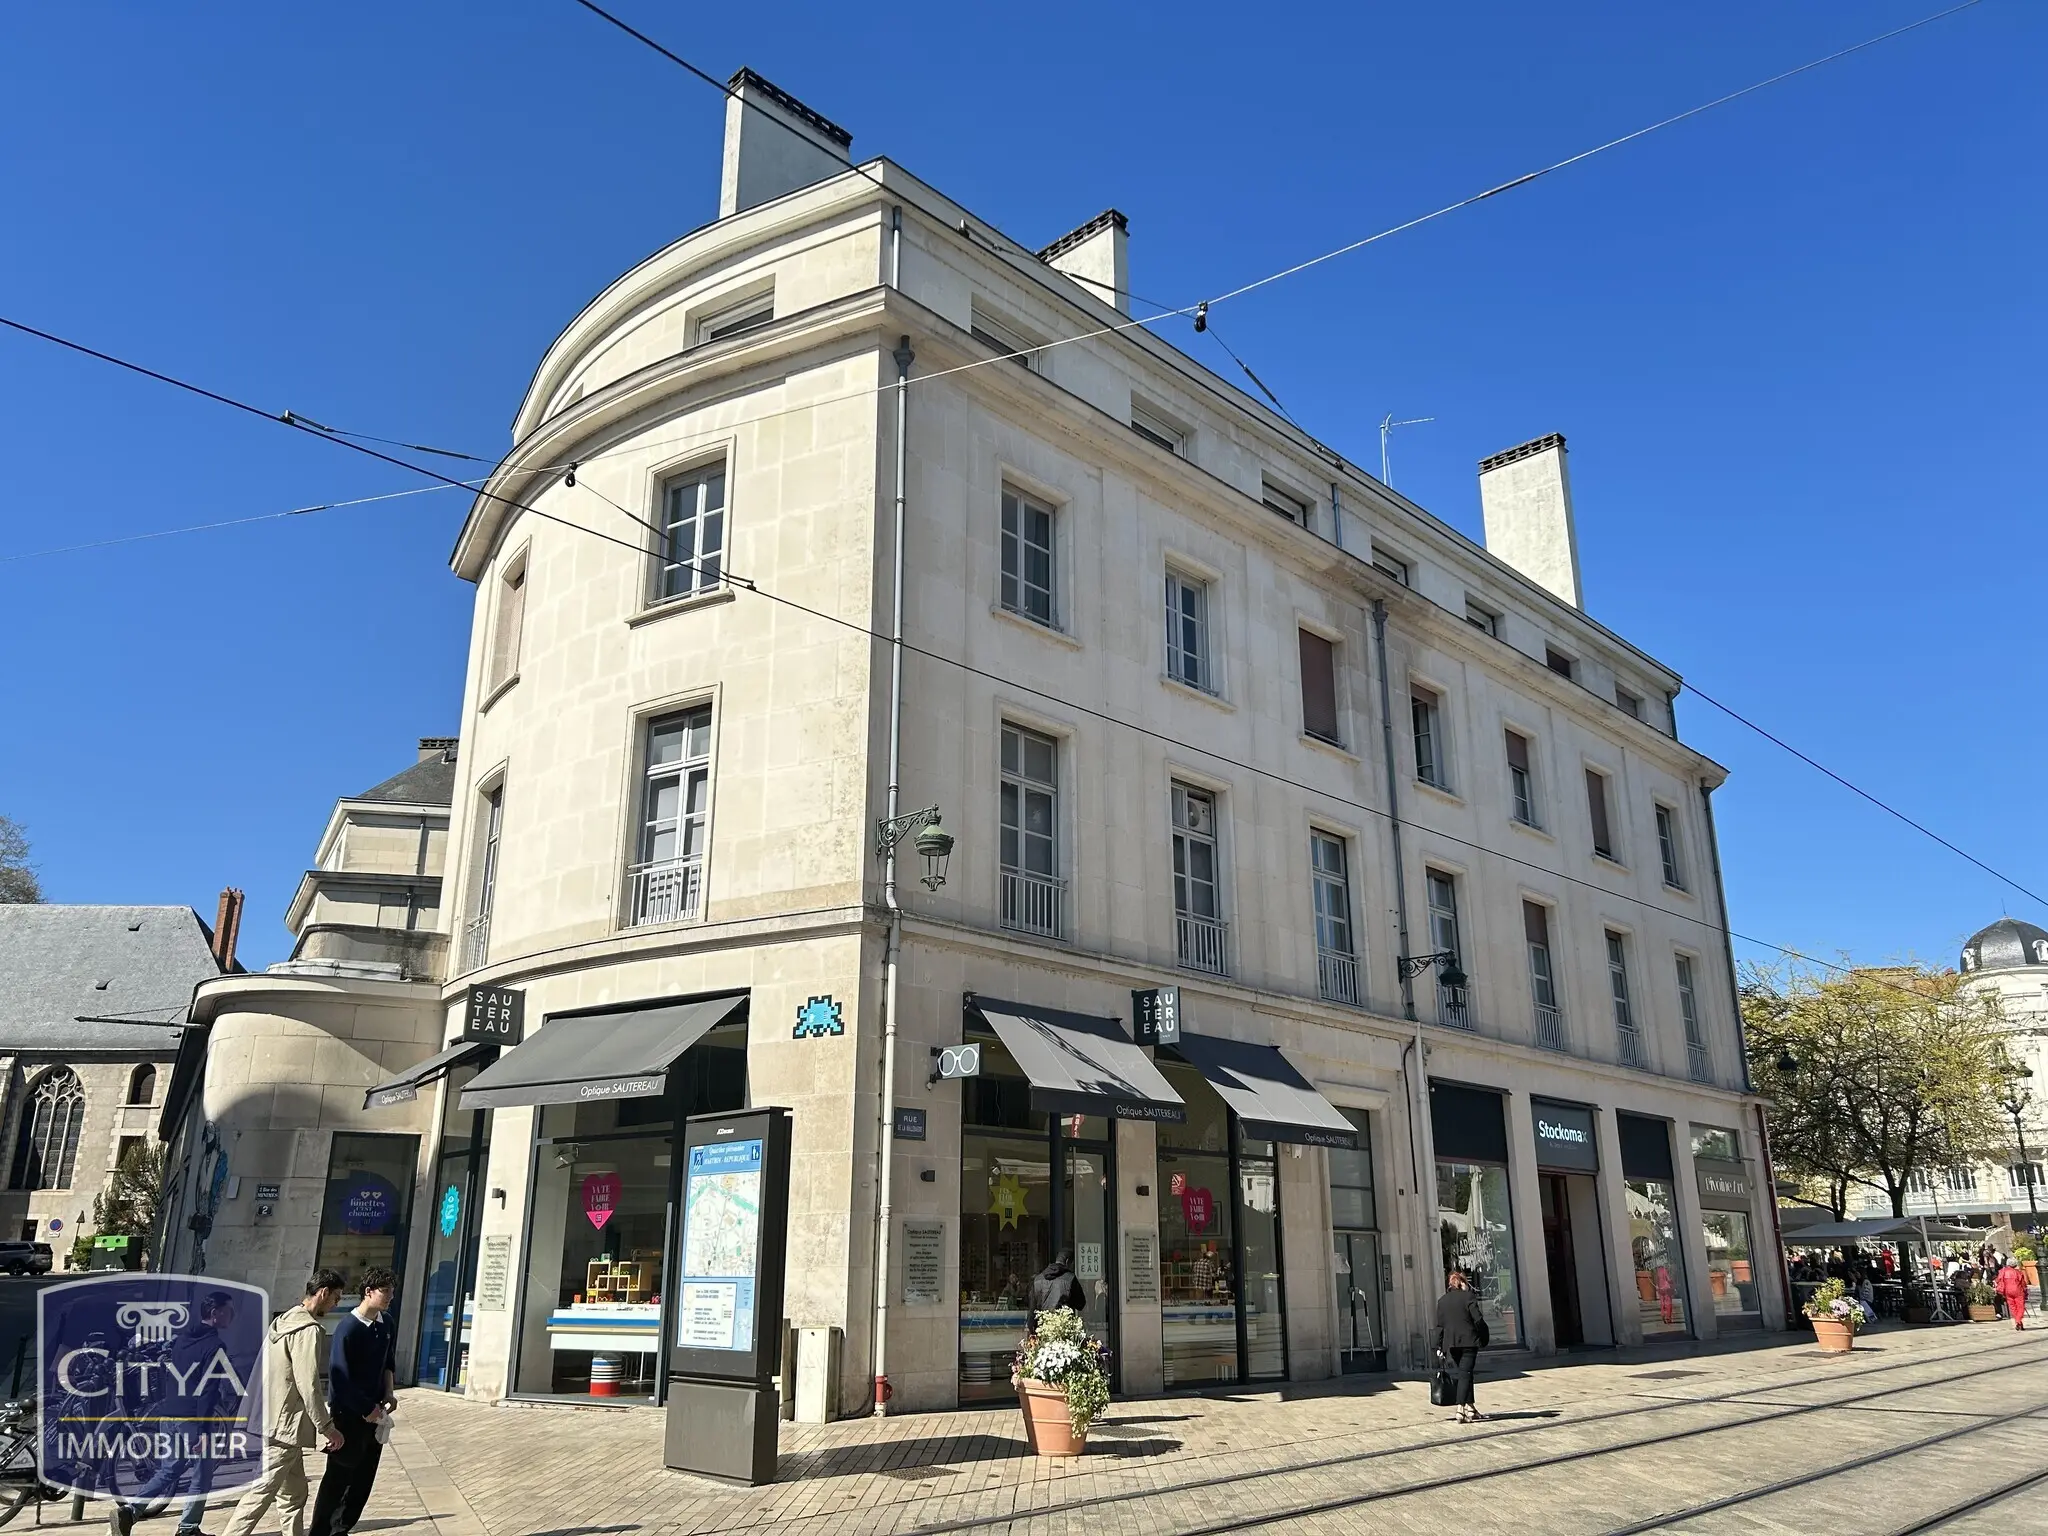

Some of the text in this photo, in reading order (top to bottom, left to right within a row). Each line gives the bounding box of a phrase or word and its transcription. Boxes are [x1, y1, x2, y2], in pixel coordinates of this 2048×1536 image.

[475, 991, 512, 1006] SAU
[1143, 993, 1174, 1007] SAU
[474, 1005, 510, 1020] TER
[1143, 1007, 1174, 1021] TER
[471, 1018, 509, 1033] EAU
[1143, 1020, 1174, 1034] EAU
[580, 1080, 659, 1098] Optique SAUTEREAU
[903, 1115, 918, 1123] RUE
[1115, 1104, 1181, 1120] Optique SAUTEREAU
[1304, 1132, 1326, 1143] Optique
[1538, 1120, 1588, 1143] Stockomax
[262, 1205, 269, 1215] 2
[350, 1199, 385, 1208] lunettes
[348, 1209, 381, 1217] chouette
[1080, 1246, 1099, 1254] SAU
[1080, 1255, 1099, 1264] TER
[1080, 1264, 1099, 1273] EAU
